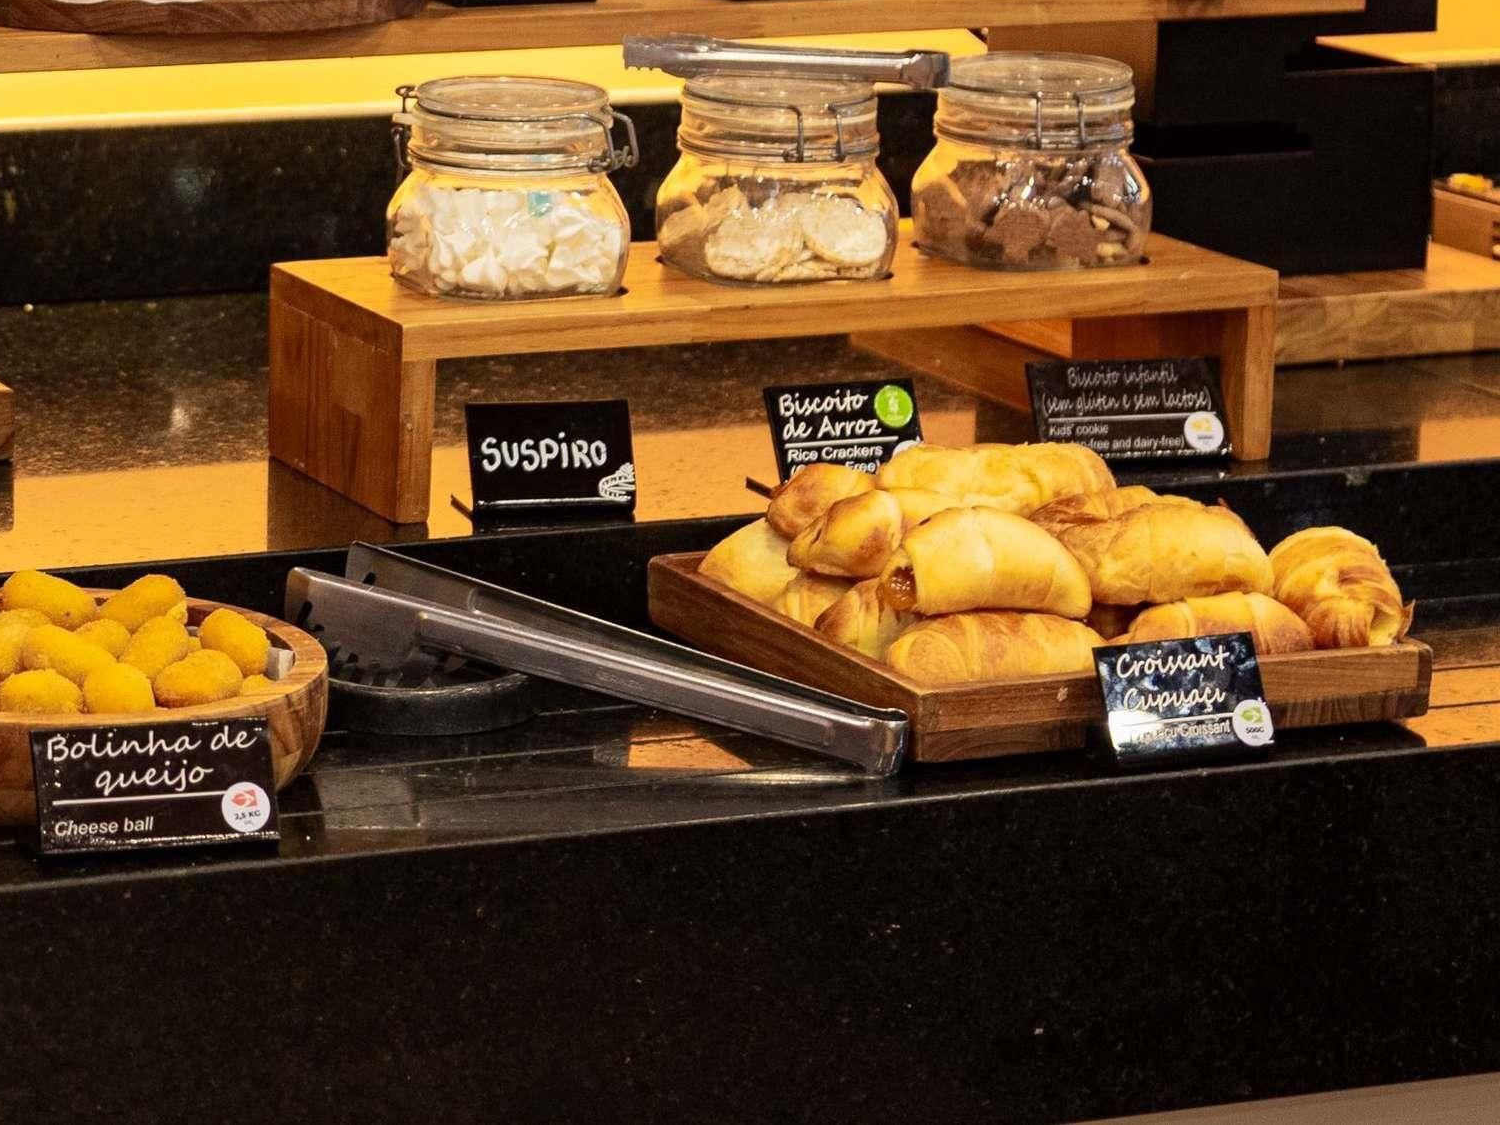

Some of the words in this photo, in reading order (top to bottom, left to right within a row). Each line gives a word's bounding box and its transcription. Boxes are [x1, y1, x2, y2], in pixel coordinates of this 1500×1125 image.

[1067, 366, 1121, 389] Biscoito
[1122, 362, 1179, 389] infantil
[778, 389, 869, 418] Biscoito
[1133, 393, 1160, 412] sem
[782, 417, 813, 441] de
[817, 415, 882, 439] Arroz
[1075, 423, 1109, 436] cookie
[787, 447, 818, 463] Rice
[821, 444, 884, 460] Crackers
[1112, 437, 1131, 450] and
[1133, 435, 1185, 452] dairy-free)
[1116, 644, 1231, 679] Croissant
[1179, 718, 1231, 738] Croissant
[46, 729, 203, 763] Bolinha
[210, 725, 258, 752] de
[95, 759, 215, 797] queijo
[54, 819, 120, 837] Cheese
[123, 815, 155, 834] ball
